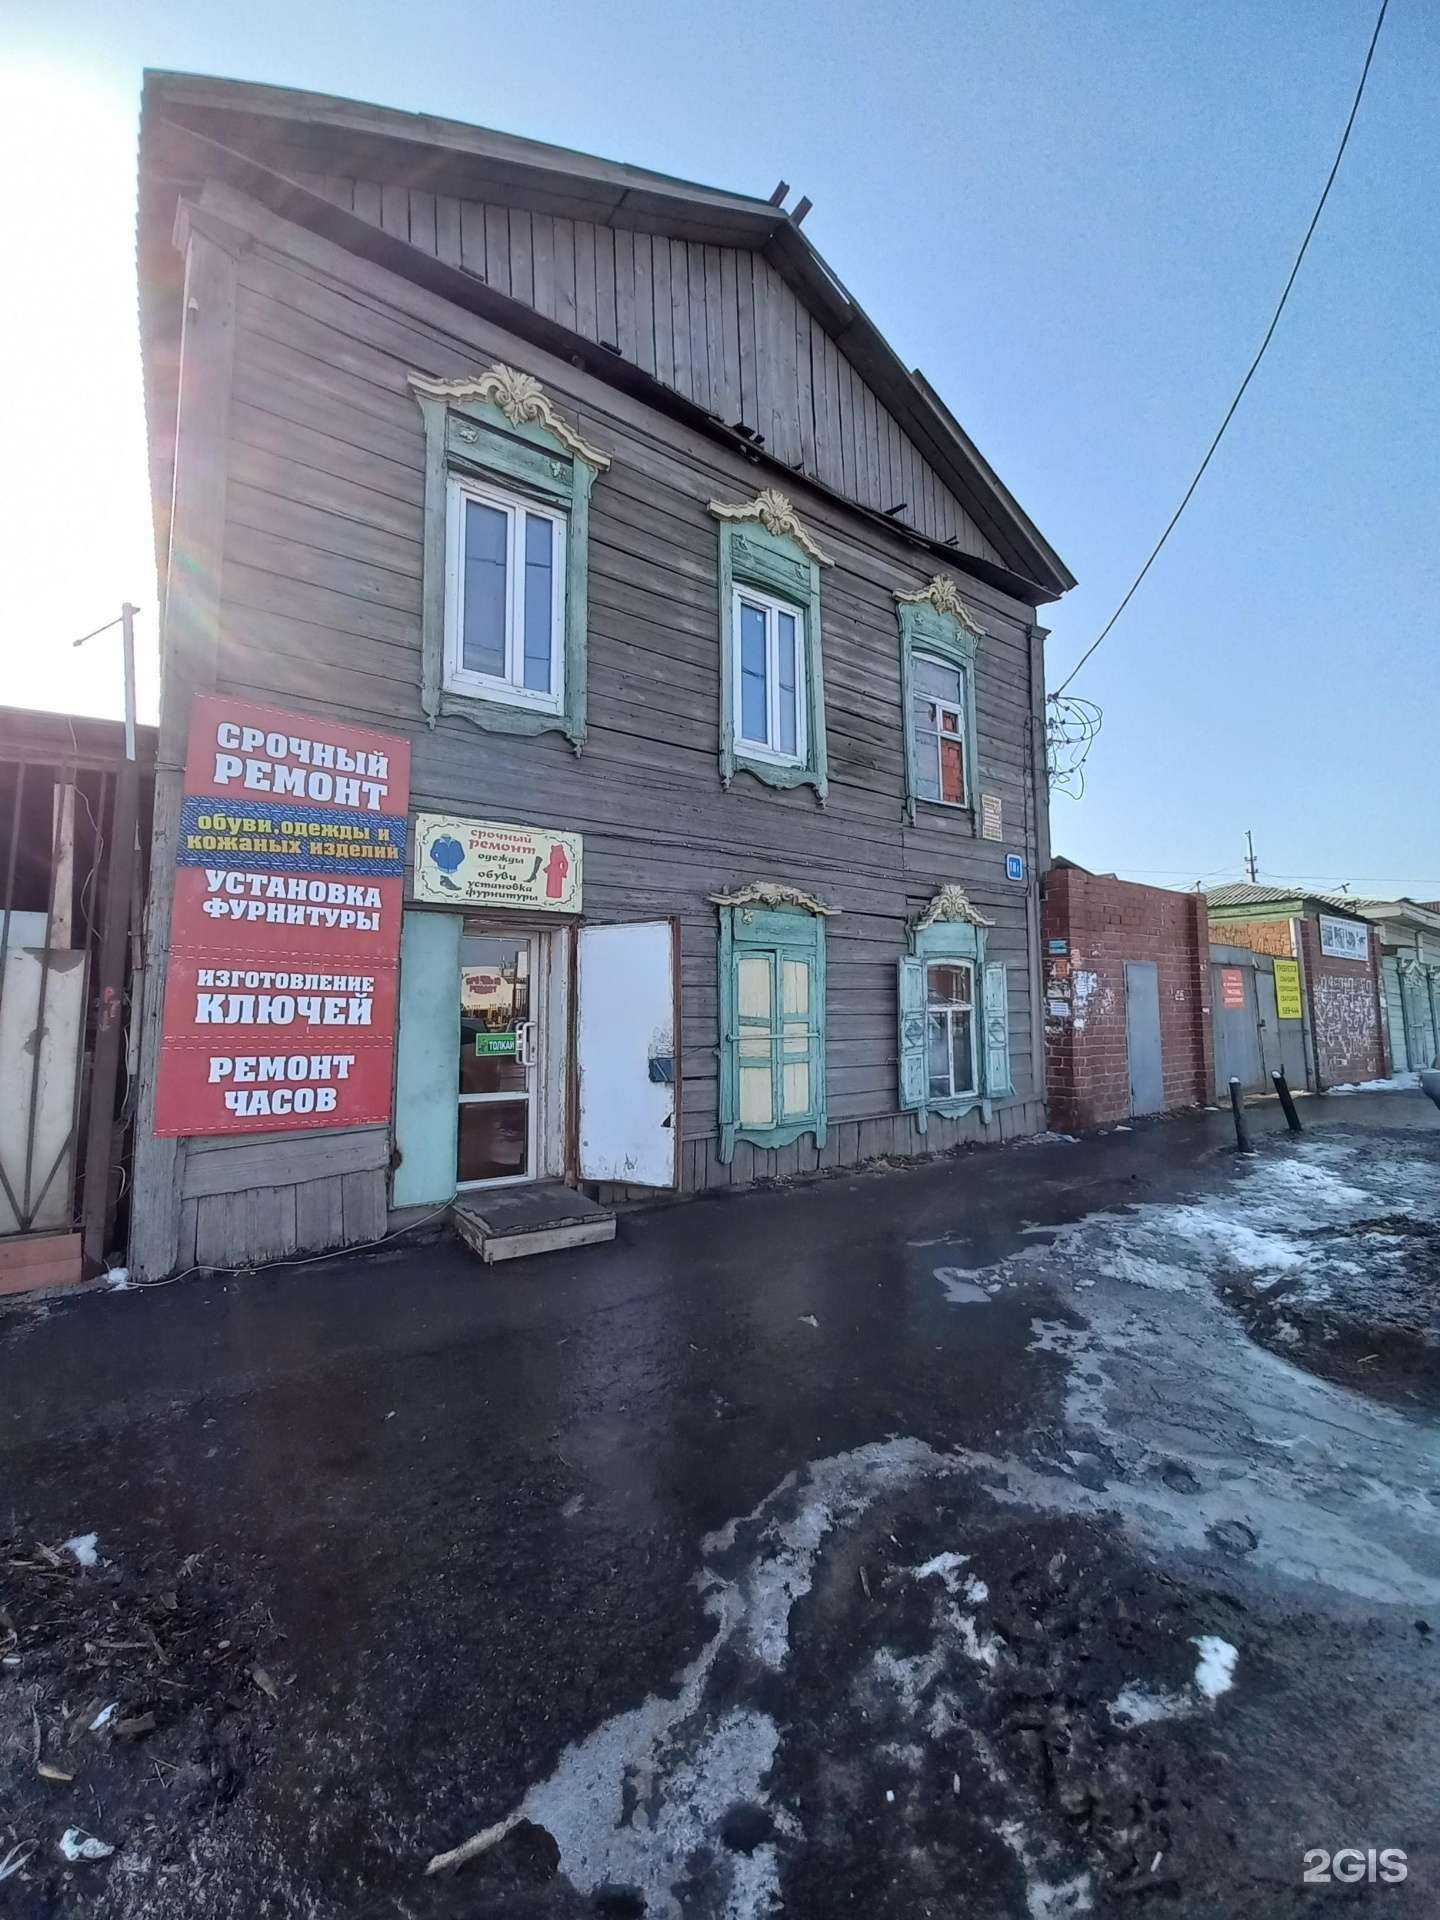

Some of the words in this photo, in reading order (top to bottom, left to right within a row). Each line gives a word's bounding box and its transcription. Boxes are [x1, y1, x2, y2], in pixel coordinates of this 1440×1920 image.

[216, 722, 389, 779] СРОЧНЫЙ
[213, 753, 388, 811] РЕМОНТ
[378, 827, 389, 841] и
[470, 828, 532, 844] срочный
[187, 835, 301, 854] кожаных
[310, 840, 399, 860] изделий
[469, 838, 536, 855] ремонт
[478, 853, 524, 865] одежды
[467, 880, 532, 892] установка
[478, 870, 517, 881] обуви
[205, 869, 382, 908] УСТАНОВКА
[465, 888, 538, 902] фурнитуры
[203, 897, 380, 931] ФУРНИТУРЫ
[197, 969, 374, 992] ИЗГОТОВЛЕНИЕ
[195, 992, 373, 1025] КЛЮЧЕЙ
[207, 1055, 355, 1083] РЕМОНТ
[224, 1087, 337, 1117] ЧАСОВ
